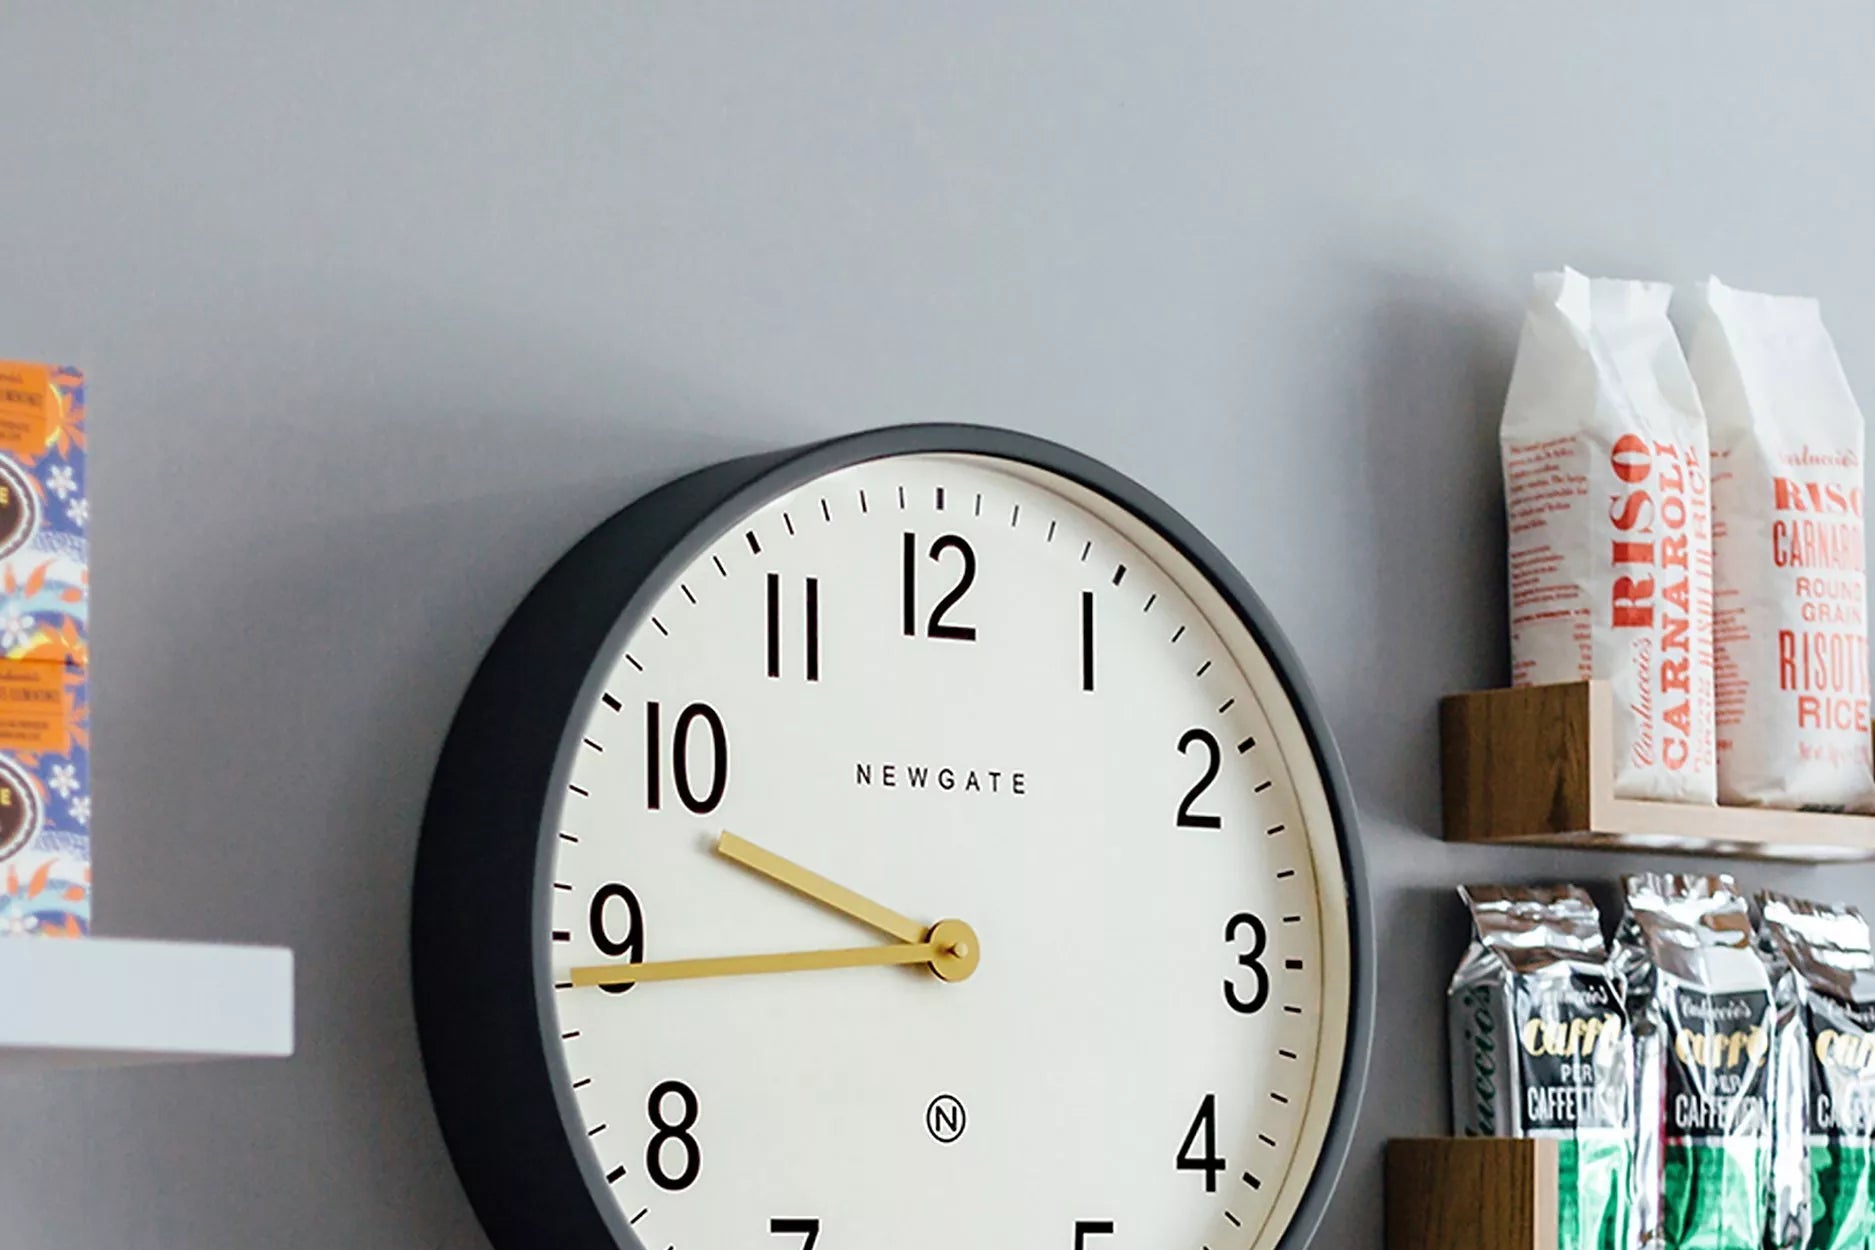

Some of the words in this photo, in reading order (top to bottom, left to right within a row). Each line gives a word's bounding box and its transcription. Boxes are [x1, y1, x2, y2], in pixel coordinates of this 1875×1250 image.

[1609, 433, 1656, 628] RISO
[767, 573, 819, 681] 11
[903, 532, 977, 641] 12
[1652, 440, 1691, 771] CARNAROLI
[1082, 591, 1094, 692] 1
[647, 701, 728, 814] 10
[1797, 695, 1868, 732] RICE
[856, 762, 1025, 795] NEWGATE
[1177, 729, 1222, 828] 2
[589, 883, 644, 994] 9
[1223, 913, 1269, 1014] 3
[646, 1080, 701, 1191] 8
[1176, 1094, 1225, 1193] 4
